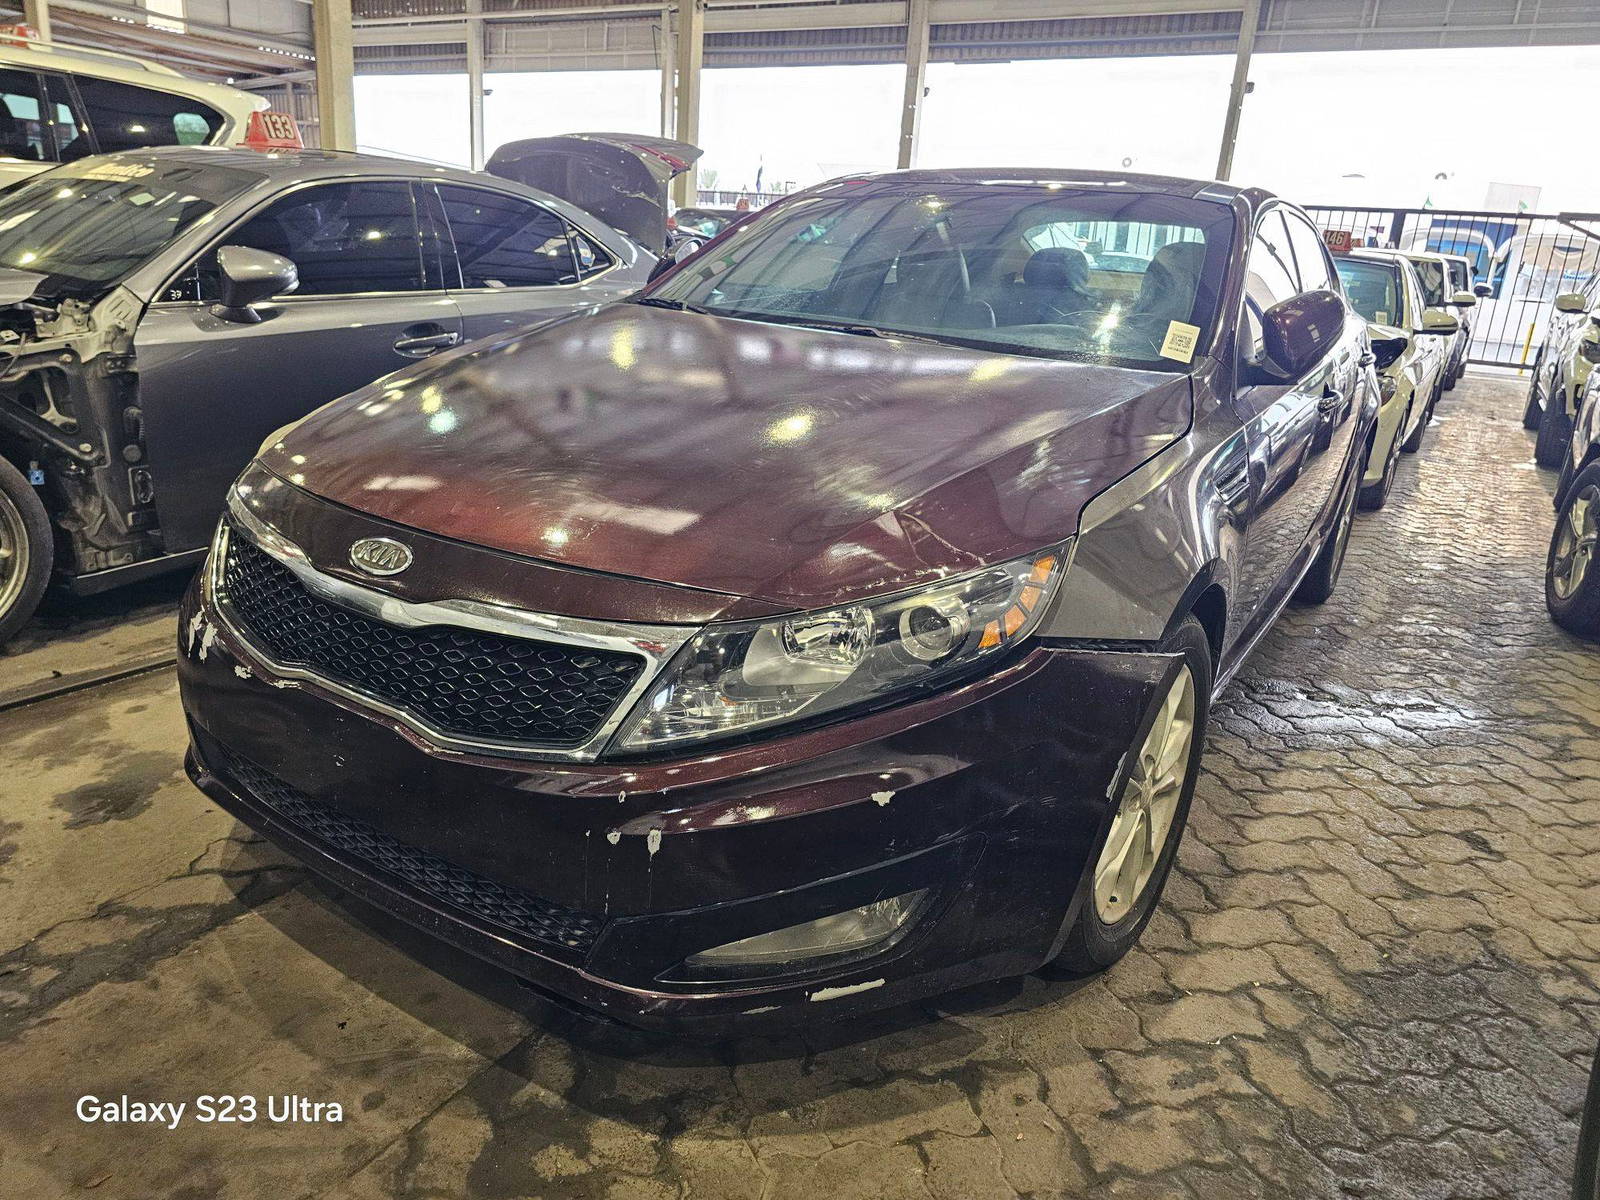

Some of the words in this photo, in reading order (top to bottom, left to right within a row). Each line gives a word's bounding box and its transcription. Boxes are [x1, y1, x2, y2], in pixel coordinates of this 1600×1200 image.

[263, 113, 296, 139] 133
[1324, 230, 1345, 246] 146
[357, 541, 401, 569] KIA
